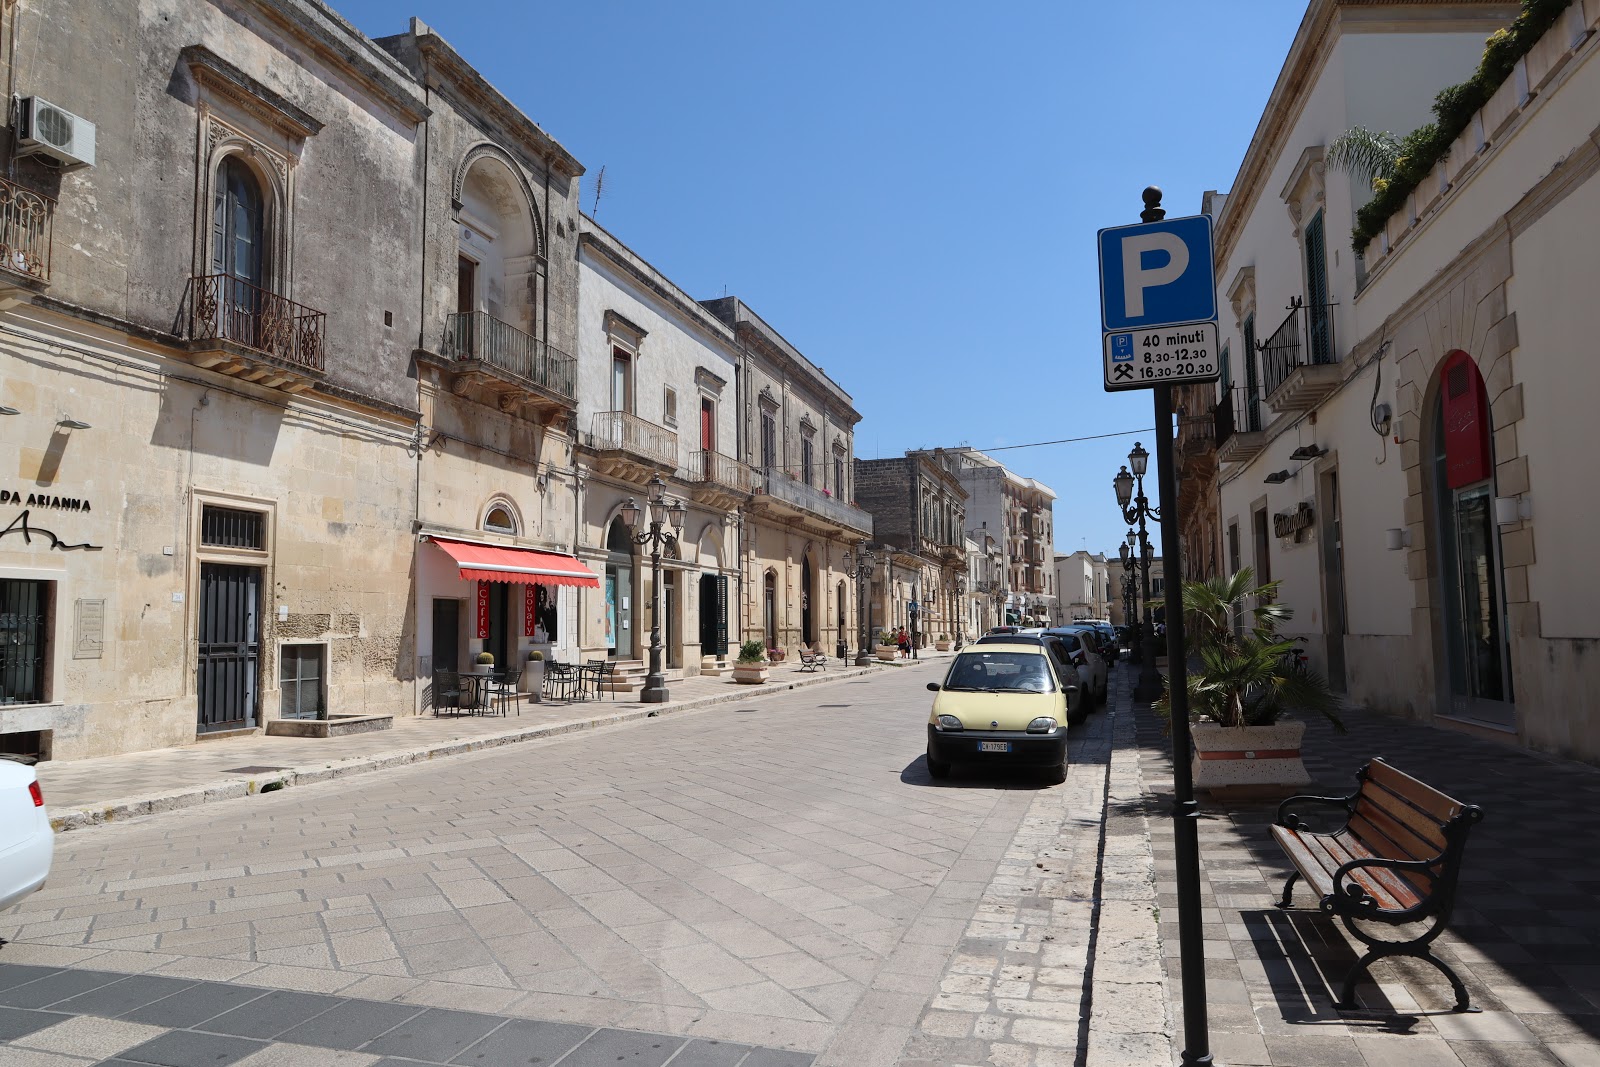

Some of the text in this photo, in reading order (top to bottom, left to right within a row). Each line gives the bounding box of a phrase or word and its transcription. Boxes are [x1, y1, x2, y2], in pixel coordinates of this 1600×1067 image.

[1121, 231, 1190, 319] P
[1142, 330, 1205, 348] 40 minuti
[26, 493, 91, 511] ARIANNA
[479, 589, 487, 638] Caffè
[526, 590, 534, 636] Bovary
